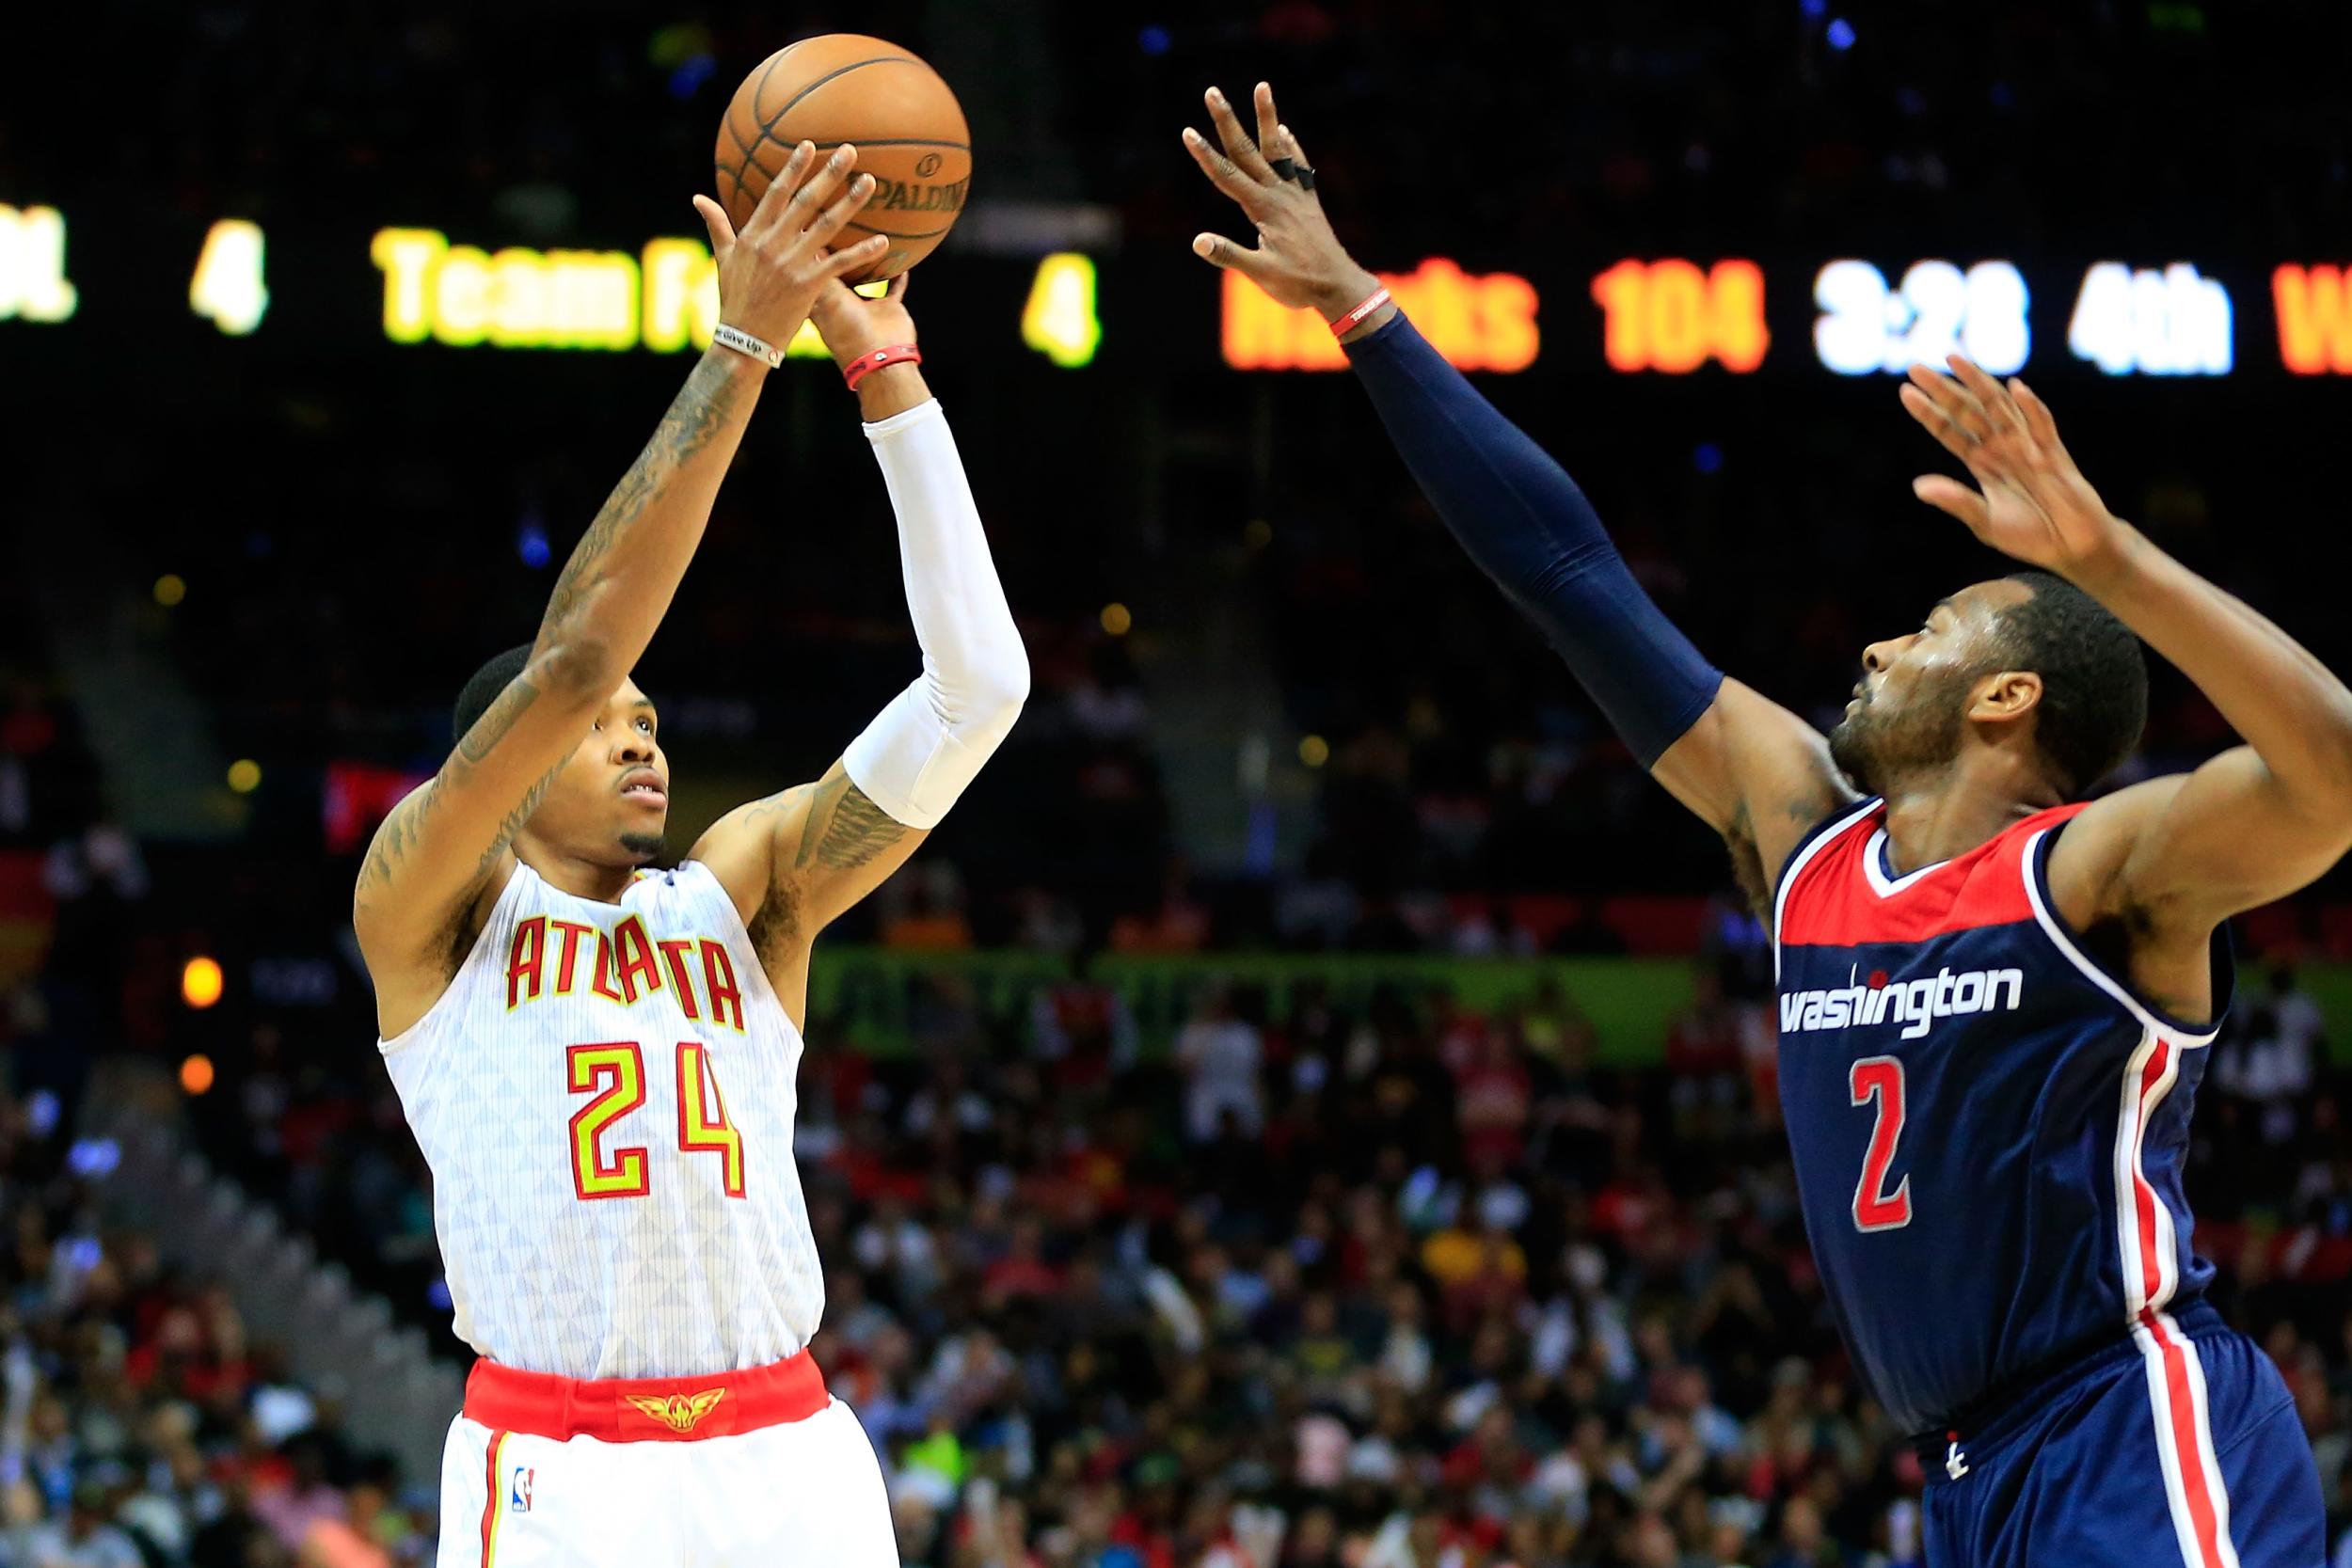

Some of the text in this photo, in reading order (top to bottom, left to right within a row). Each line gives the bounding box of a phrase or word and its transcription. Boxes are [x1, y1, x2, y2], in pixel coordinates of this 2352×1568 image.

[190, 219, 269, 335] 4
[371, 227, 642, 348] Team
[1022, 253, 1102, 367] 4
[1591, 259, 1770, 373] 104
[2068, 262, 2235, 376] 4th
[506, 912, 745, 1034] ATLATA
[1780, 962, 2023, 1040] washington
[566, 1041, 746, 1199] 24
[1850, 1054, 1913, 1233] 2
